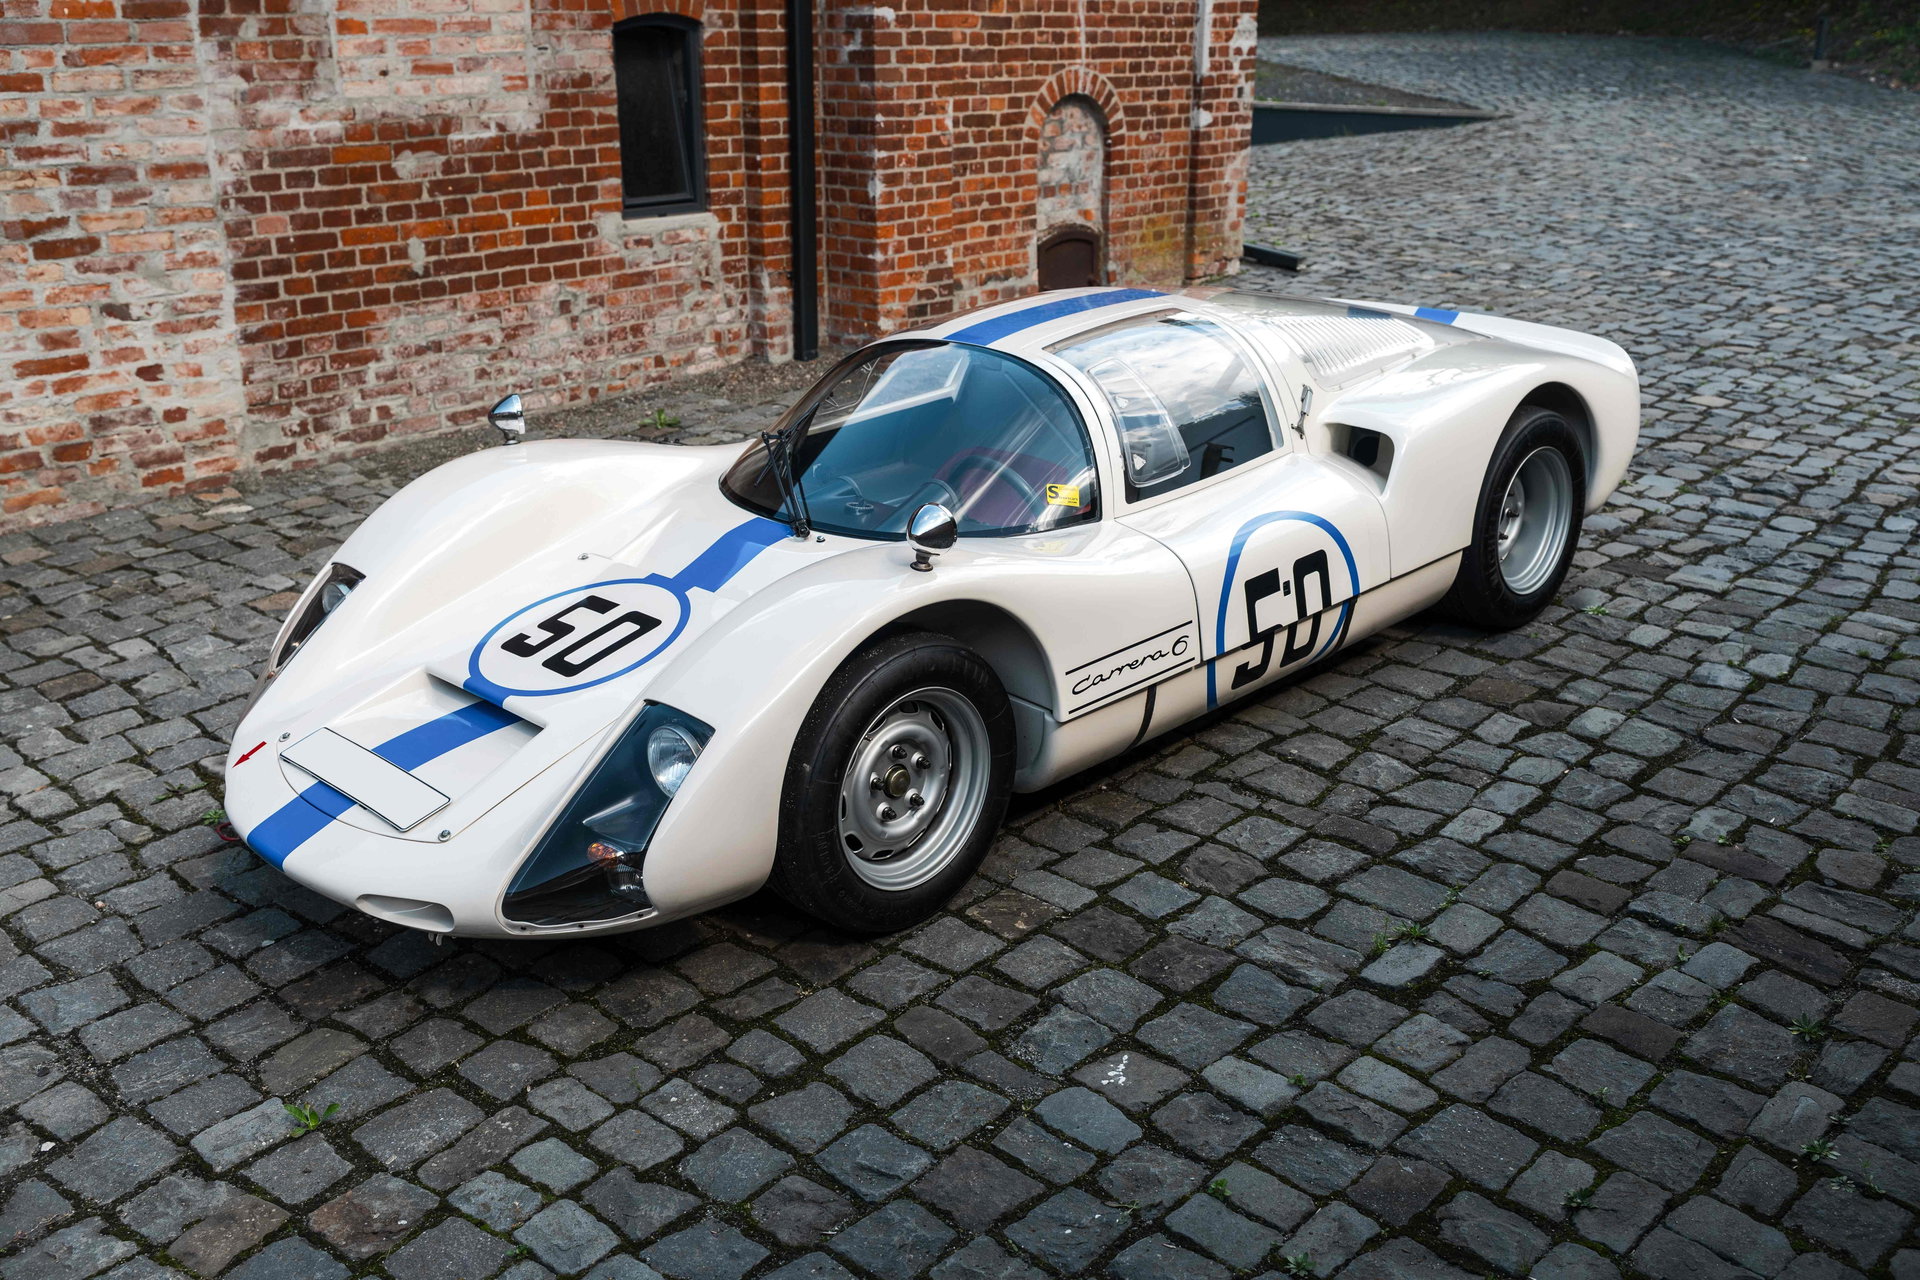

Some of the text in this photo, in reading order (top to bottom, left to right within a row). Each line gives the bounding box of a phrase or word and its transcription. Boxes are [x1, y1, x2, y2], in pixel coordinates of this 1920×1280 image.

[1047, 485, 1060, 499] S
[500, 594, 662, 678] 50
[1231, 549, 1332, 690] 50
